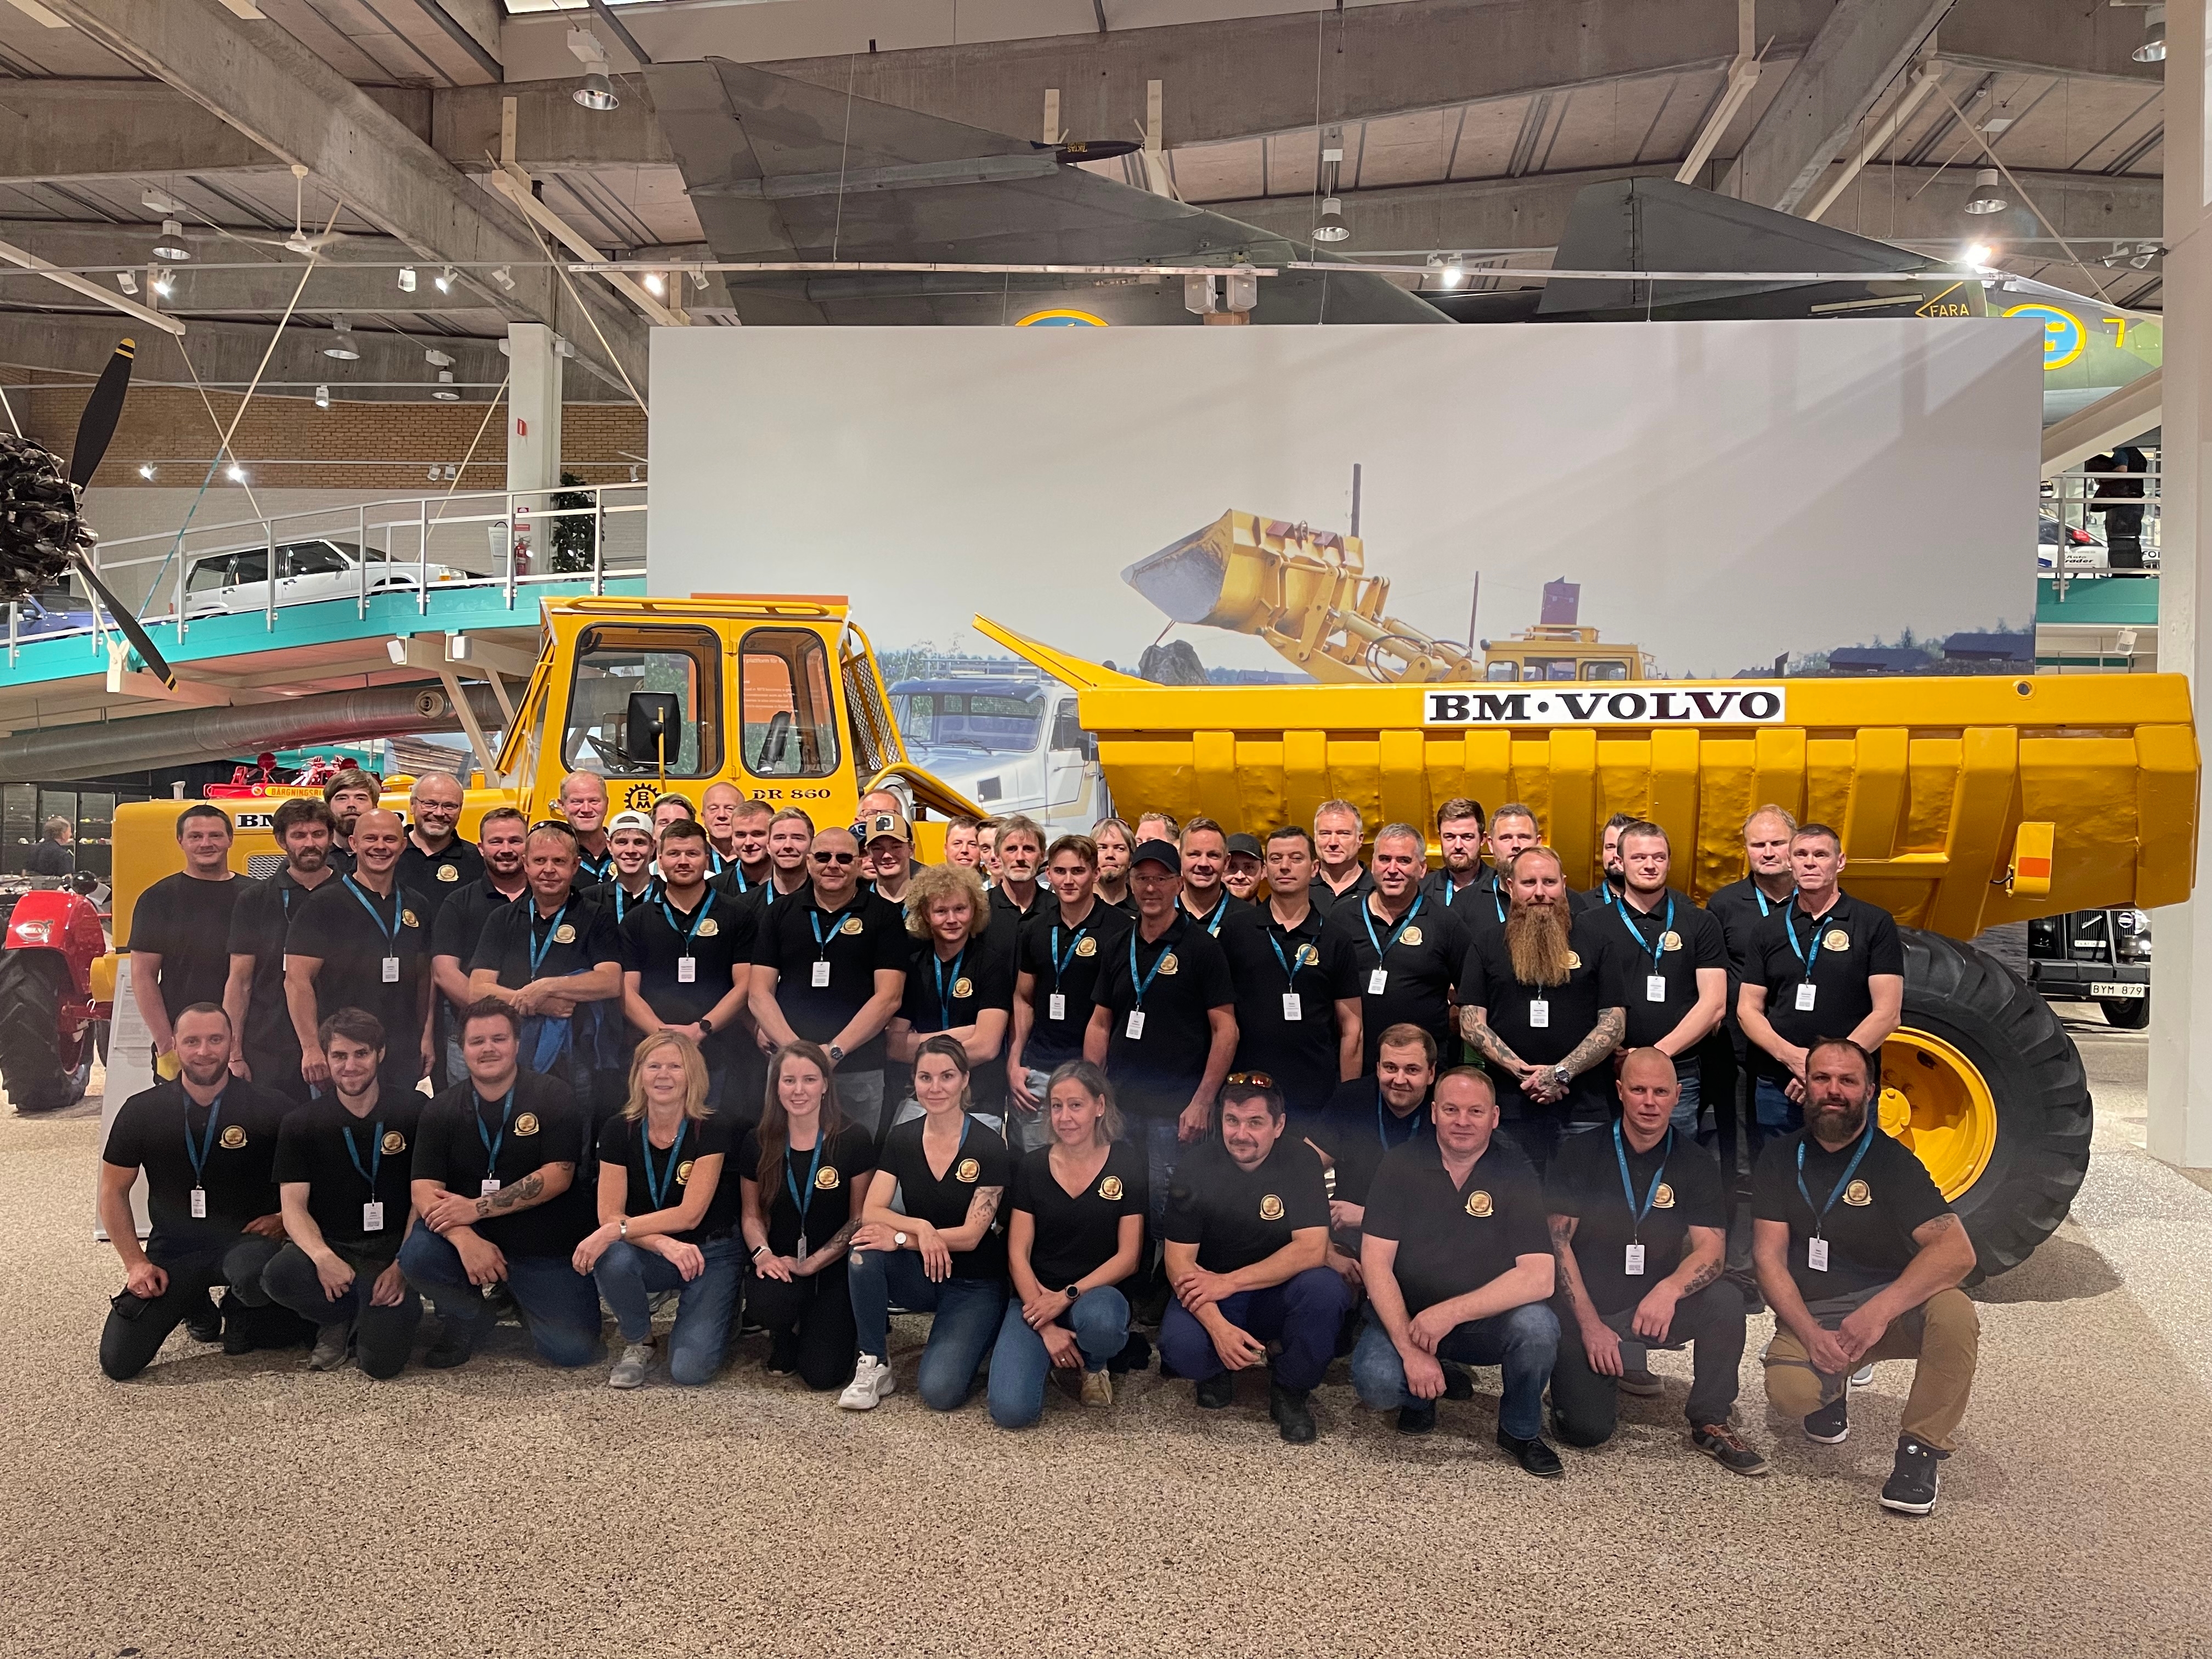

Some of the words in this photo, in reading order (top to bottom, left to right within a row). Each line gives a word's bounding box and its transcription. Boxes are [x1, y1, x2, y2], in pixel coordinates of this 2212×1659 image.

[1930, 303, 1970, 317] FARA
[2102, 318, 2126, 348] 7
[752, 789, 785, 799] DR
[791, 788, 831, 799] 860
[2093, 985, 2114, 994] BYM
[2121, 986, 2142, 995] 879
